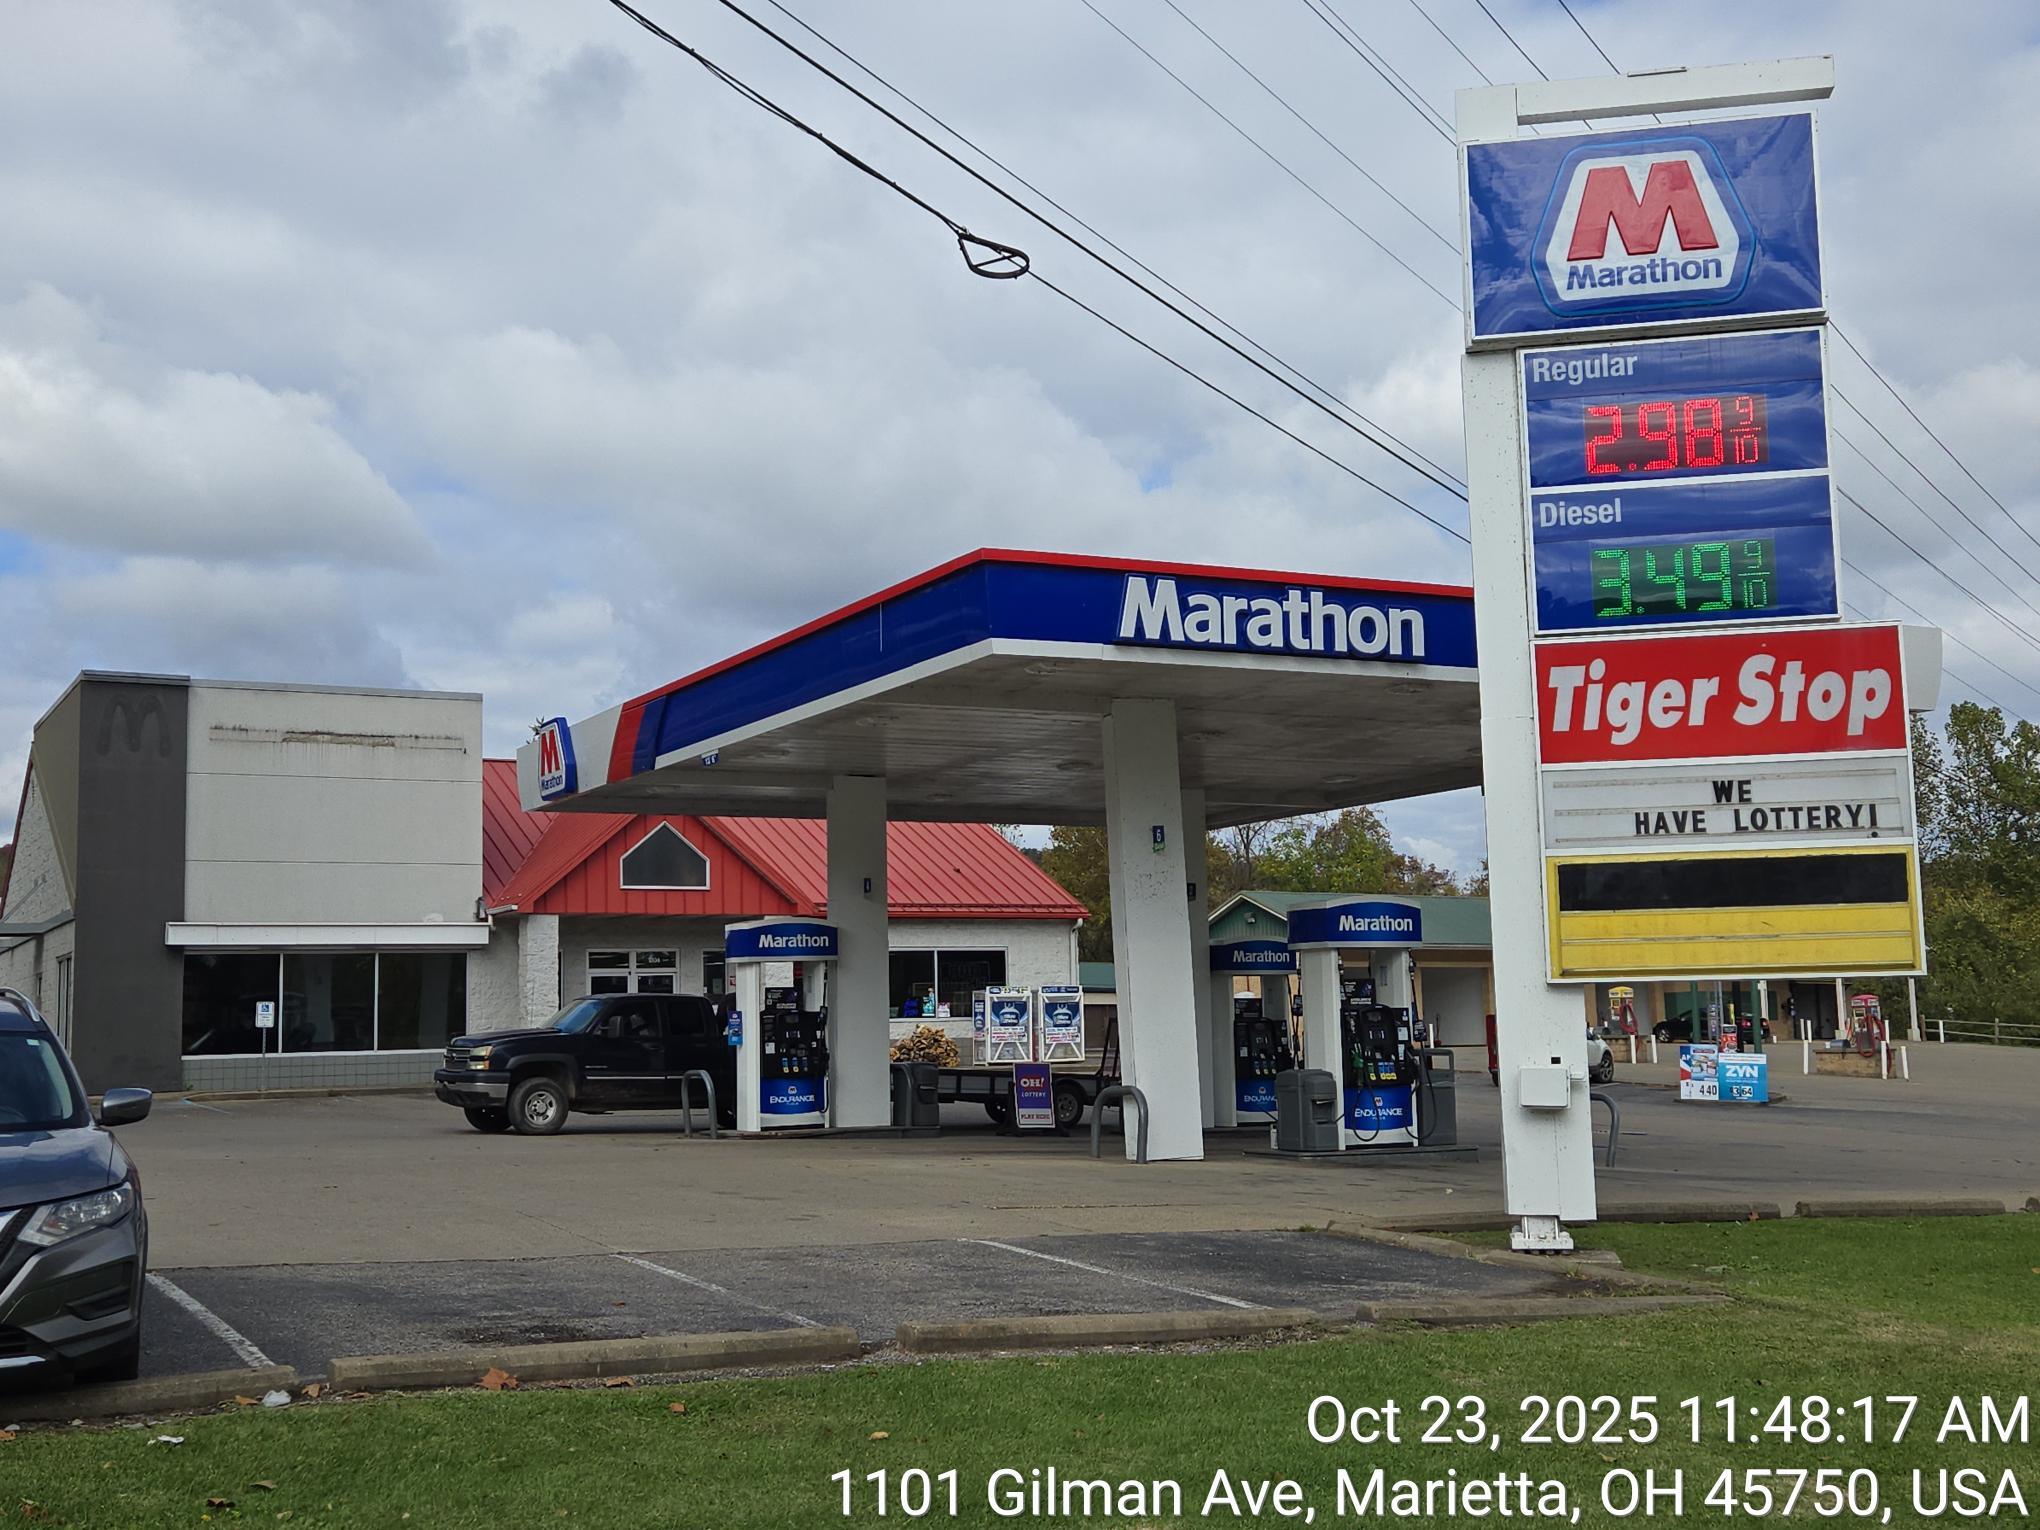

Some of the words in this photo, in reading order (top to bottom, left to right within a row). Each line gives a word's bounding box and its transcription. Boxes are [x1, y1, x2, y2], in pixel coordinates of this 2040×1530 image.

[1566, 257, 1722, 290] Marathon
[1533, 353, 1638, 386] Regular
[1586, 398, 1724, 474] 2.98
[1540, 498, 1622, 528] Diesel
[1595, 543, 1733, 617] 3.49
[1119, 576, 1425, 657] Marathon
[1548, 658, 1719, 746] Tiger
[1733, 654, 1892, 737] Stop
[541, 773, 563, 792] Marathon
[1713, 780, 1752, 804] WE
[1635, 810, 1707, 836] HAVE
[1734, 803, 1880, 839] LOTTERY!
[1339, 914, 1413, 931] Marathon
[759, 933, 829, 948] Marathon
[1233, 950, 1290, 963] Marathon
[1020, 1077, 1045, 1088] OH!
[769, 1095, 815, 1104] ENDURANCE
